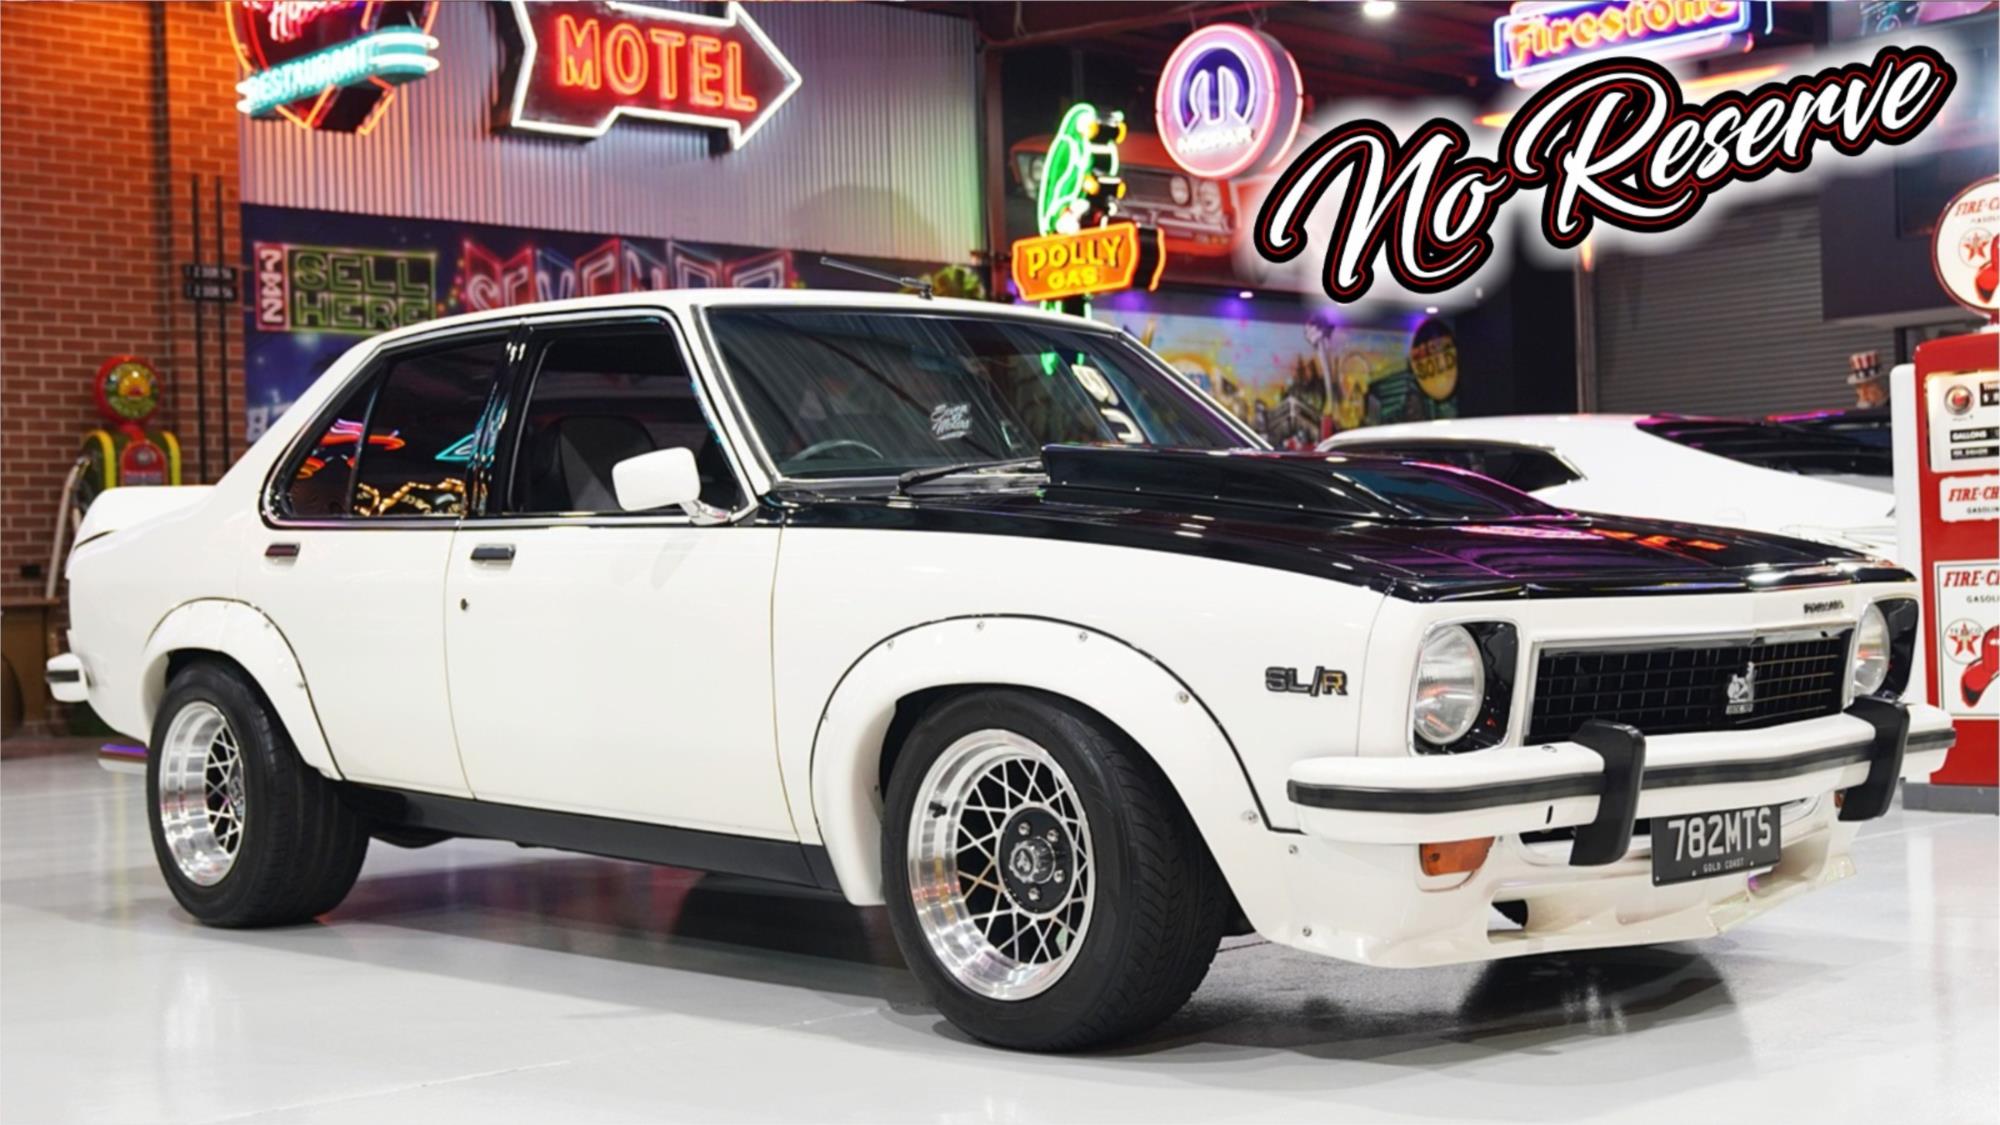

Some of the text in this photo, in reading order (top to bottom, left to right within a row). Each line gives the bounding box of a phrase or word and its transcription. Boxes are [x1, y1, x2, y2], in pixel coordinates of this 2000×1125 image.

[557, 14, 757, 111] MOTEL
[294, 252, 429, 296] SELL
[1026, 235, 1122, 278] POLLY
[1047, 266, 1098, 290] GAS
[294, 291, 429, 330] HERE
[1265, 666, 1348, 697] SL/R
[1667, 806, 1772, 862] 782MTS
[1703, 858, 1744, 873] GOLD COAST
